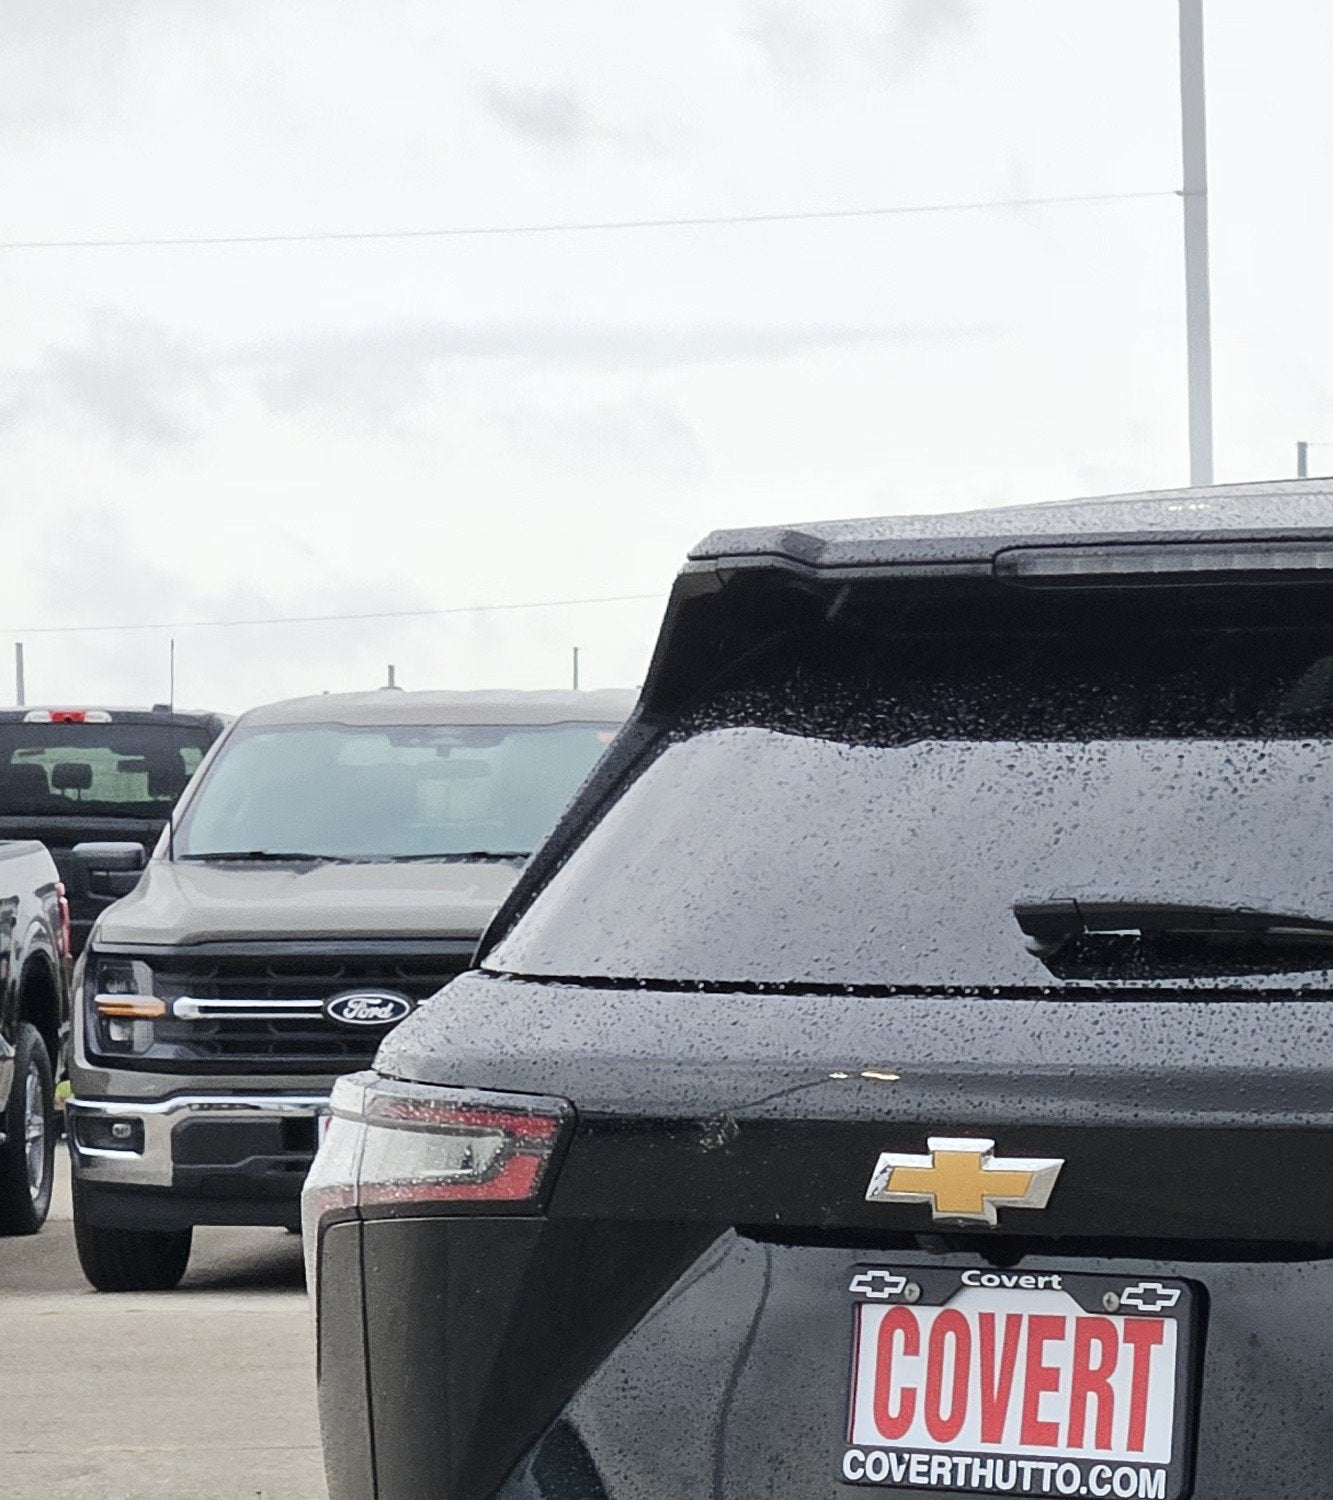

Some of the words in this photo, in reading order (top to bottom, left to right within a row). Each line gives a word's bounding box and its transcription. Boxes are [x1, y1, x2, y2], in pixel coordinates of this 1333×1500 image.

[342, 998, 394, 1019] Ford
[960, 1269, 1063, 1290] Covert
[873, 1306, 1165, 1453] COVERT
[842, 1449, 1167, 1500] COVERTHUTTO.COM
